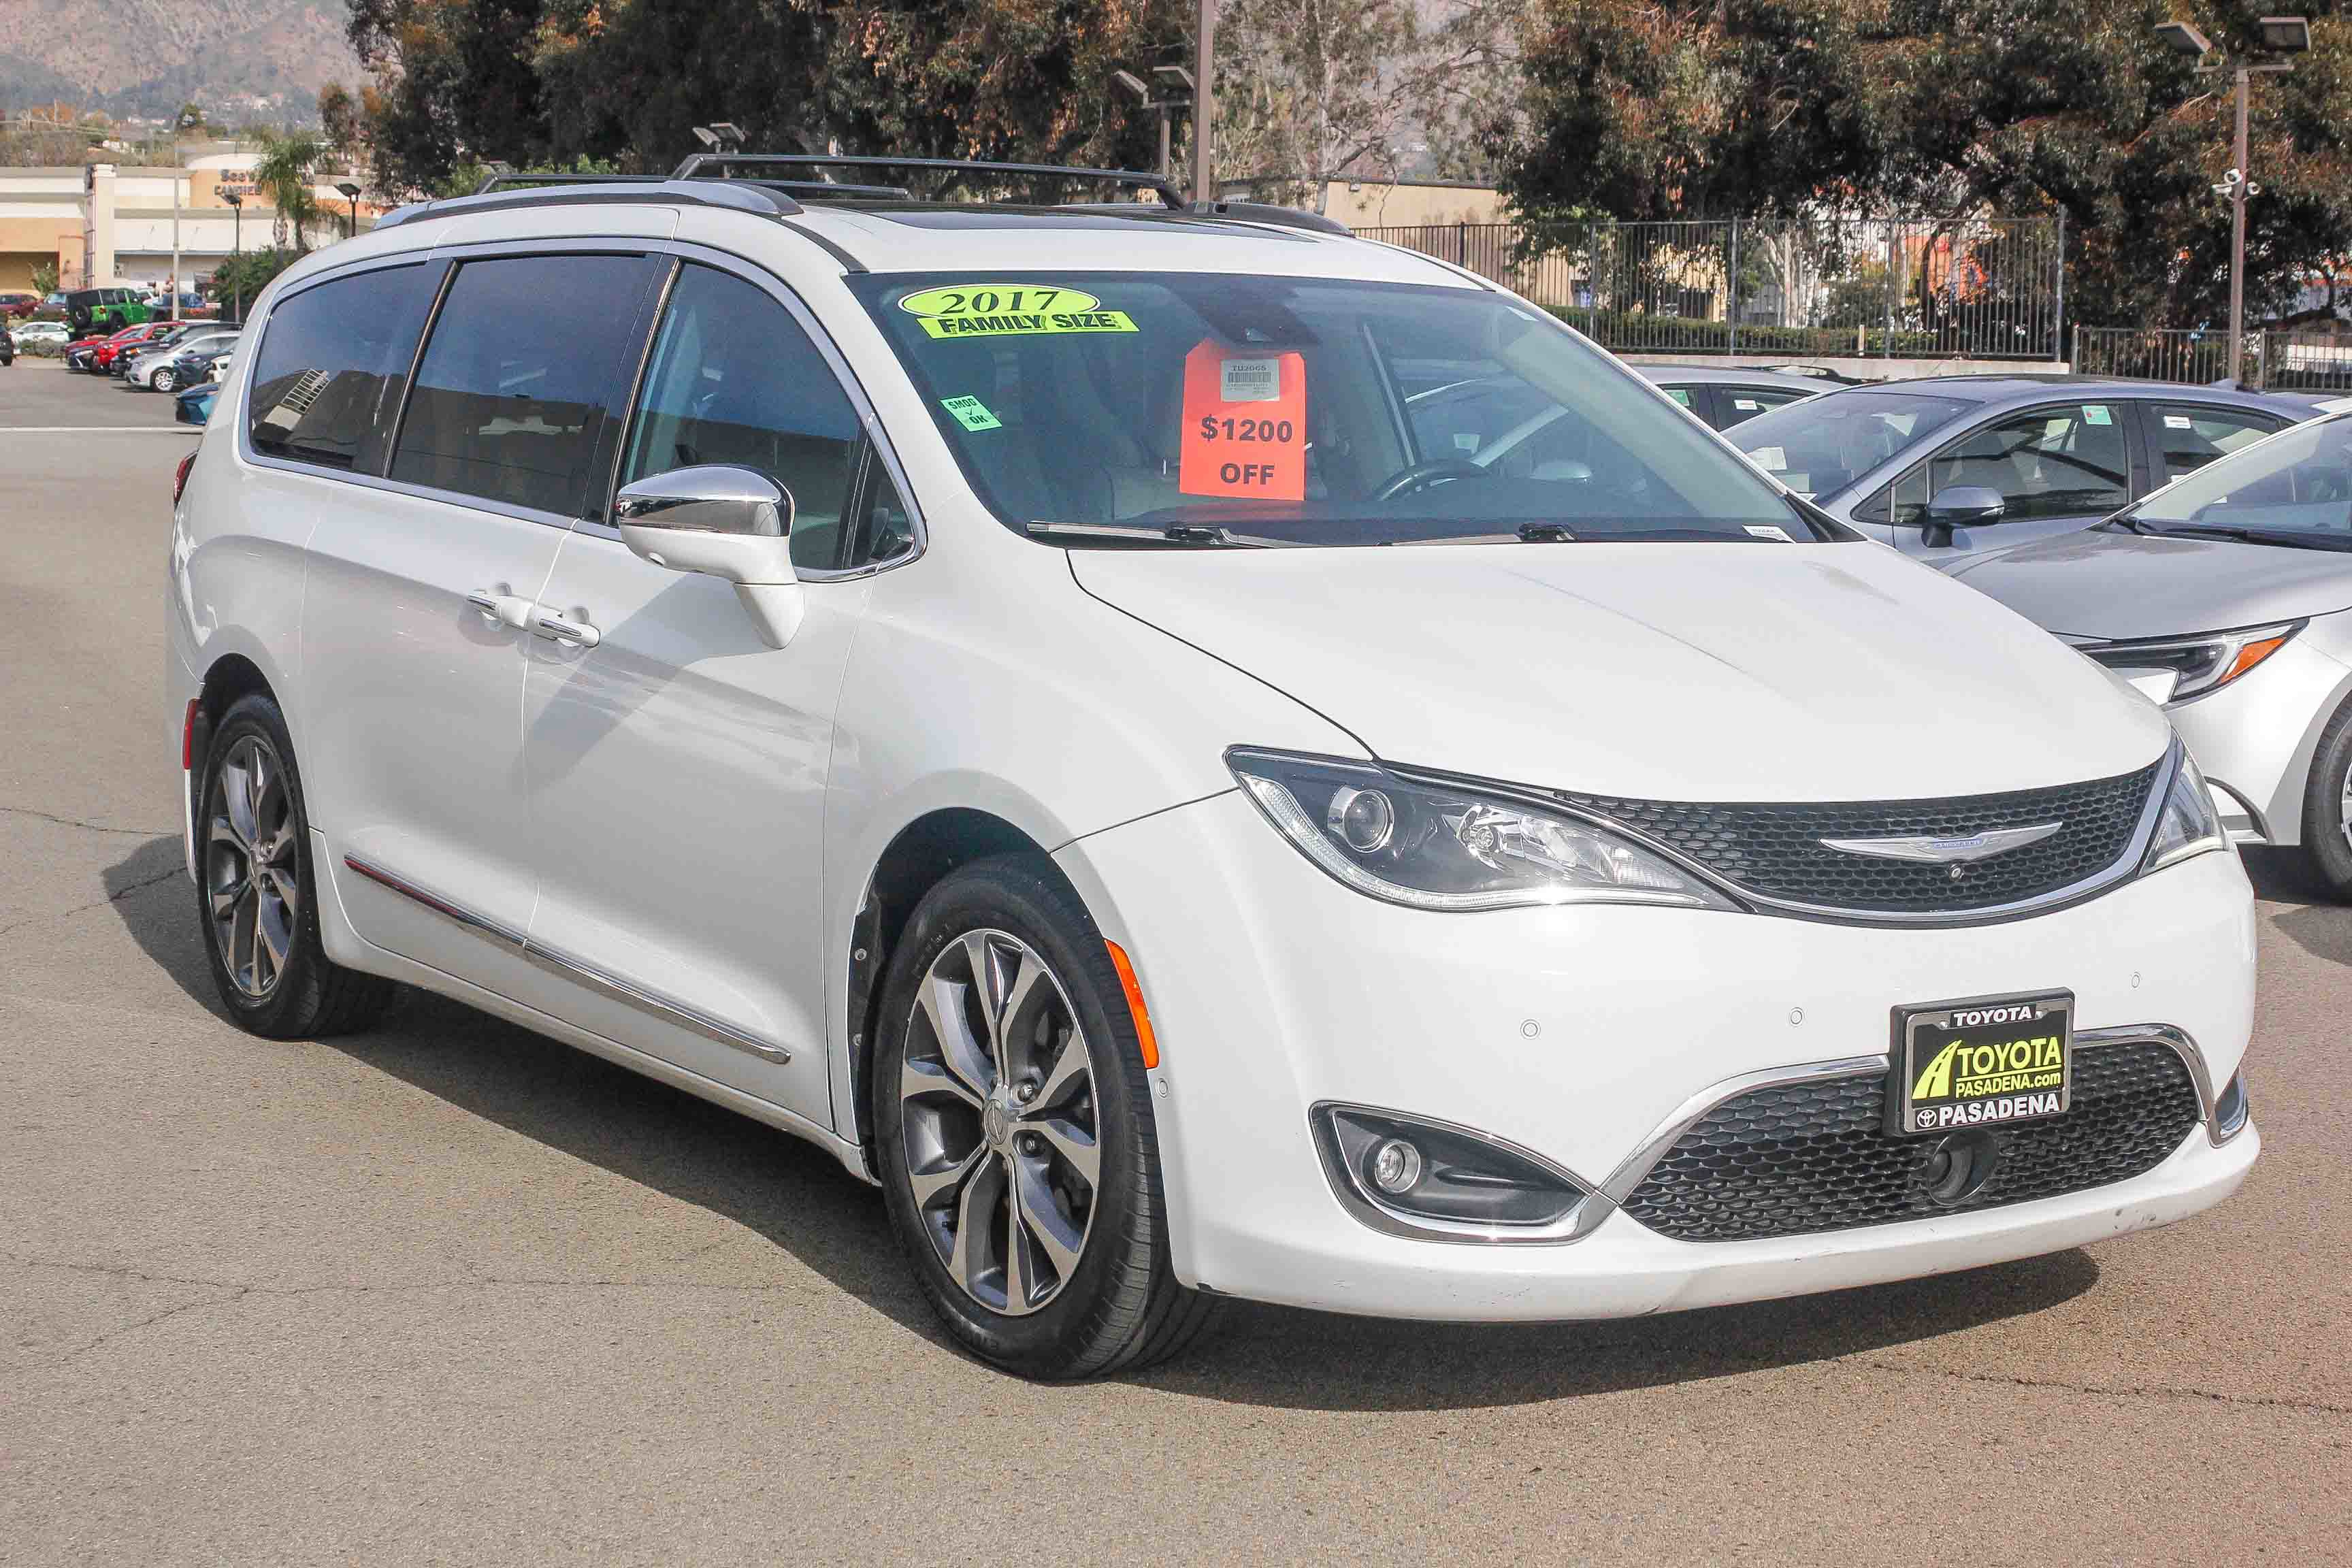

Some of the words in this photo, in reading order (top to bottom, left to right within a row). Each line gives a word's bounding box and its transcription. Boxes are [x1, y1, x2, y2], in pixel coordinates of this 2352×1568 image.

[941, 291, 1060, 314] 2017
[938, 314, 1044, 334] FAMILY
[1051, 313, 1119, 328] SIZE
[948, 398, 977, 409] SMOG
[969, 414, 989, 424] OK
[1200, 413, 1292, 442] $1200
[1220, 463, 1275, 485] OFF
[1953, 1006, 2032, 1027] TOYOTA
[1957, 1036, 2061, 1077] TOYOTA
[1956, 1072, 2061, 1098] PASADENA.com
[1939, 1093, 2059, 1126] PASADENA
